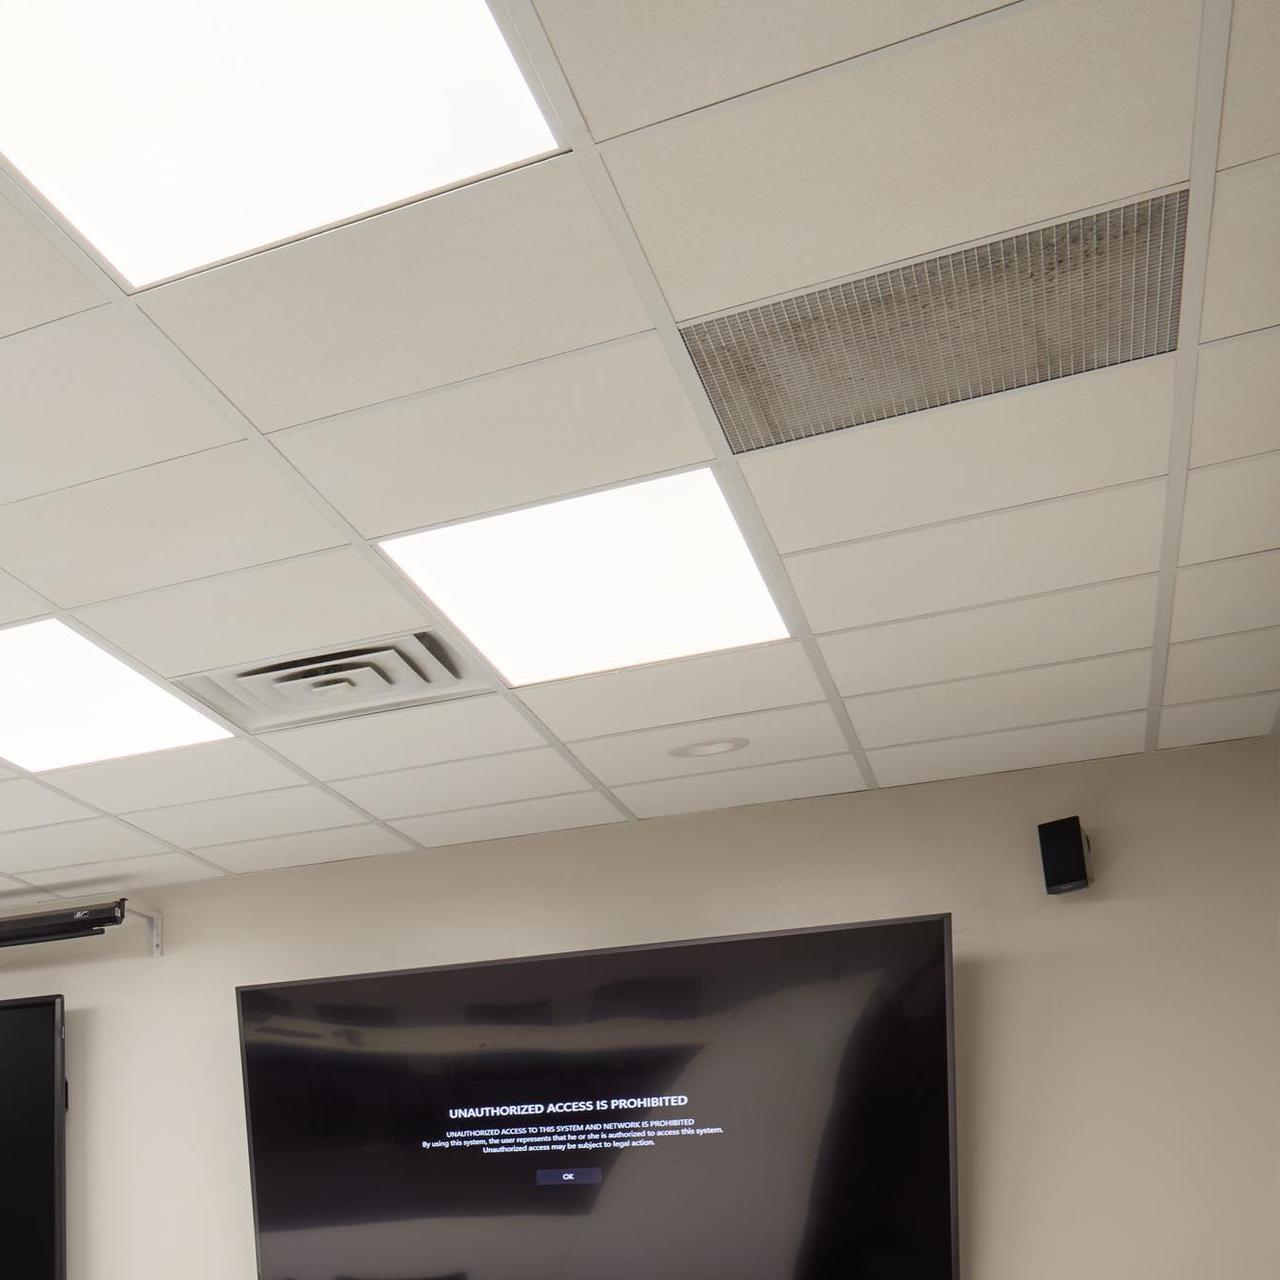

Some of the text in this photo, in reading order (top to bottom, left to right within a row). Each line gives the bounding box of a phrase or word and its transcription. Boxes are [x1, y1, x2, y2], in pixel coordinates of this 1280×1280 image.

[449, 1095, 688, 1119] UNAUTHORIZED ACCESS IS PROHIBITED
[422, 1141, 430, 1149] By
[432, 1140, 449, 1148] using
[464, 1138, 487, 1147] system,
[517, 1135, 551, 1144] represents
[608, 1129, 646, 1138] authorized
[696, 1127, 723, 1135] system.
[446, 1128, 499, 1138] UNAUTHORIZED
[501, 1127, 527, 1135] ACCESS
[556, 1124, 584, 1132] SYSTEM
[585, 1123, 602, 1131] AND
[603, 1121, 641, 1130] NETWORK
[650, 1118, 695, 1127] PROHIBITED
[483, 1145, 527, 1153] Unauthorized
[578, 1141, 602, 1150] subject
[613, 1139, 630, 1148] legal
[631, 1139, 655, 1147] action.
